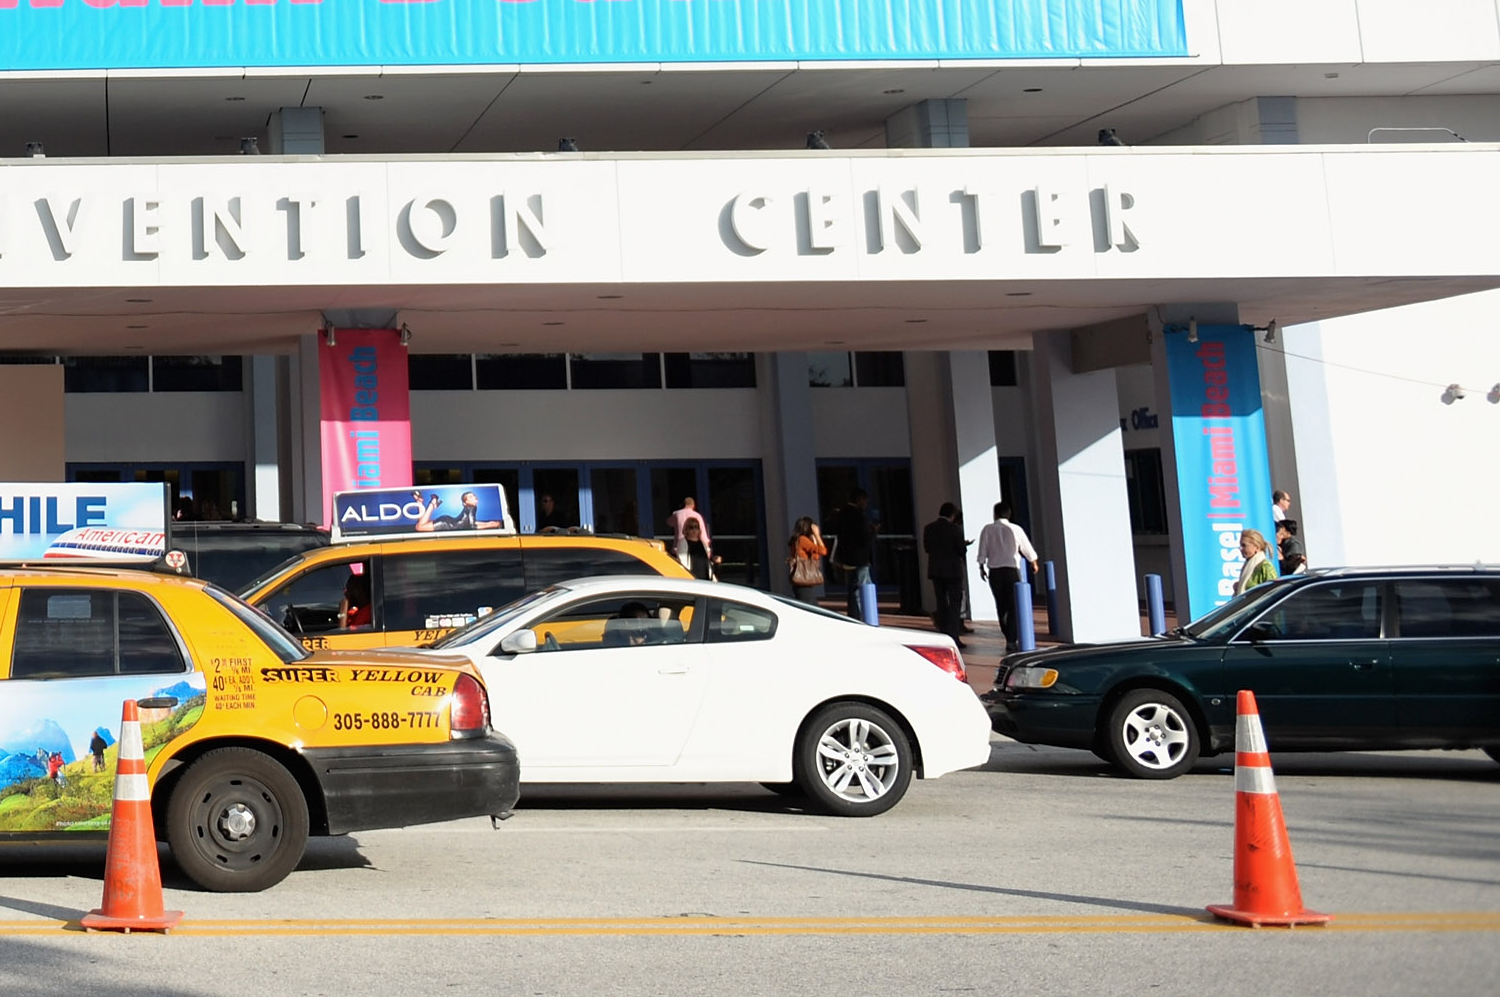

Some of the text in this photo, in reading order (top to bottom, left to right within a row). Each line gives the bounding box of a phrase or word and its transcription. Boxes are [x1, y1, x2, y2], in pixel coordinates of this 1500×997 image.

[717, 184, 1142, 258] CENTER
[1197, 341, 1231, 418] Beach
[348, 346, 381, 491] iami Beach
[1204, 427, 1240, 508] Miami
[341, 502, 426, 522] ALDO
[77, 528, 165, 546] American
[301, 636, 331, 652] PER
[229, 658, 253, 666] FIRST
[262, 668, 444, 684] SUPER YELLOW
[410, 686, 447, 697] CAB
[333, 711, 442, 730] 305-888-7777
